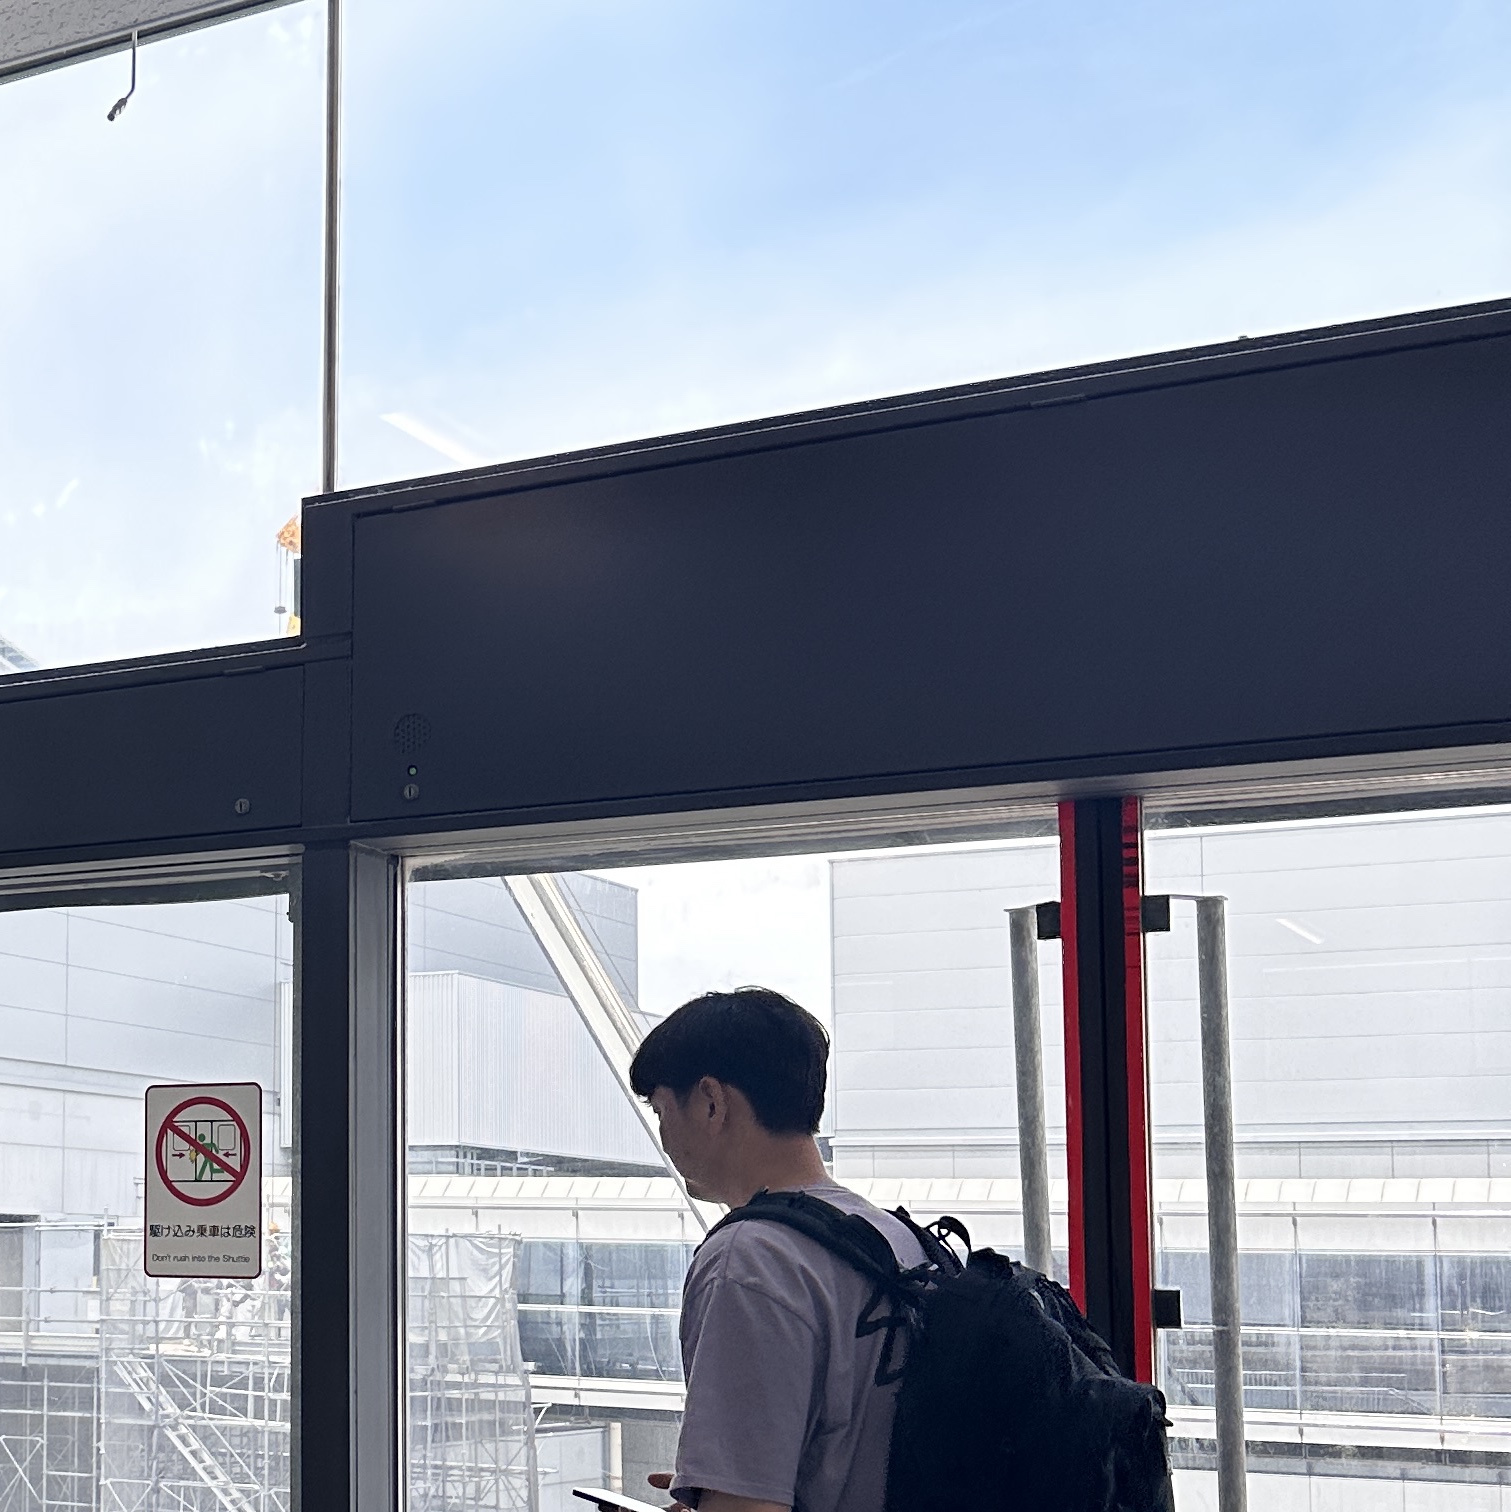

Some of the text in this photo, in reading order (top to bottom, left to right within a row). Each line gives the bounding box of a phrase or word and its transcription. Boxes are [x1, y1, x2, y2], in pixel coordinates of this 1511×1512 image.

[149, 1224, 257, 1238] 駆け込み乗車は危険
[192, 1255, 207, 1263] into
[208, 1255, 221, 1263] the
